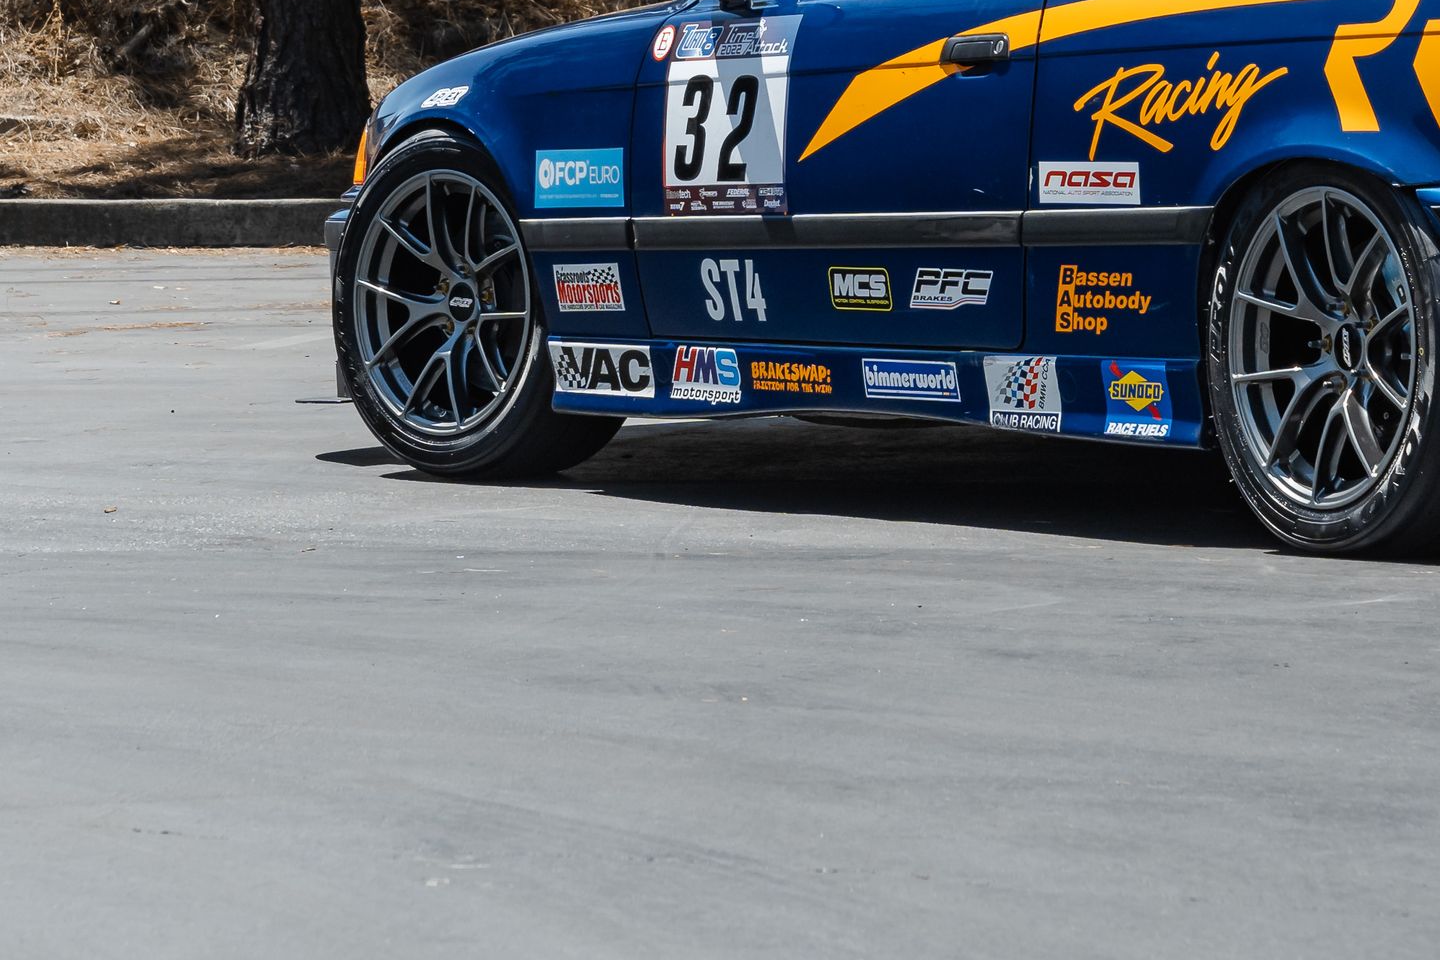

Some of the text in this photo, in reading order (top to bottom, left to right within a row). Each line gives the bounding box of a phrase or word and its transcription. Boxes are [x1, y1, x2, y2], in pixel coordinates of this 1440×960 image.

[725, 23, 761, 43] Time
[720, 38, 788, 55] 2022 Attack
[1074, 51, 1288, 161] Racing
[673, 74, 760, 182] 32
[555, 160, 620, 186] FCP EURO
[1044, 170, 1136, 188] nasa
[700, 257, 767, 322] ST4
[833, 273, 886, 298] MCS
[914, 269, 991, 296] PFC
[1062, 267, 1132, 287] Bassen
[557, 280, 621, 309] Motorsports
[1058, 289, 1152, 314] Autobody
[1059, 311, 1108, 335] Shop
[560, 346, 650, 392] VAC
[674, 347, 739, 386] HMS
[751, 361, 831, 383] BRAKESWAP:
[865, 364, 955, 390] bimmerworld
[672, 386, 740, 402] motorsport
[787, 382, 800, 392] FOR
[801, 383, 813, 393] THE
[1038, 358, 1051, 409] BMW CCA
[1112, 383, 1161, 400] SUNOCO
[1020, 415, 1057, 429] RACING
[1107, 422, 1169, 437] RACE FUELS
